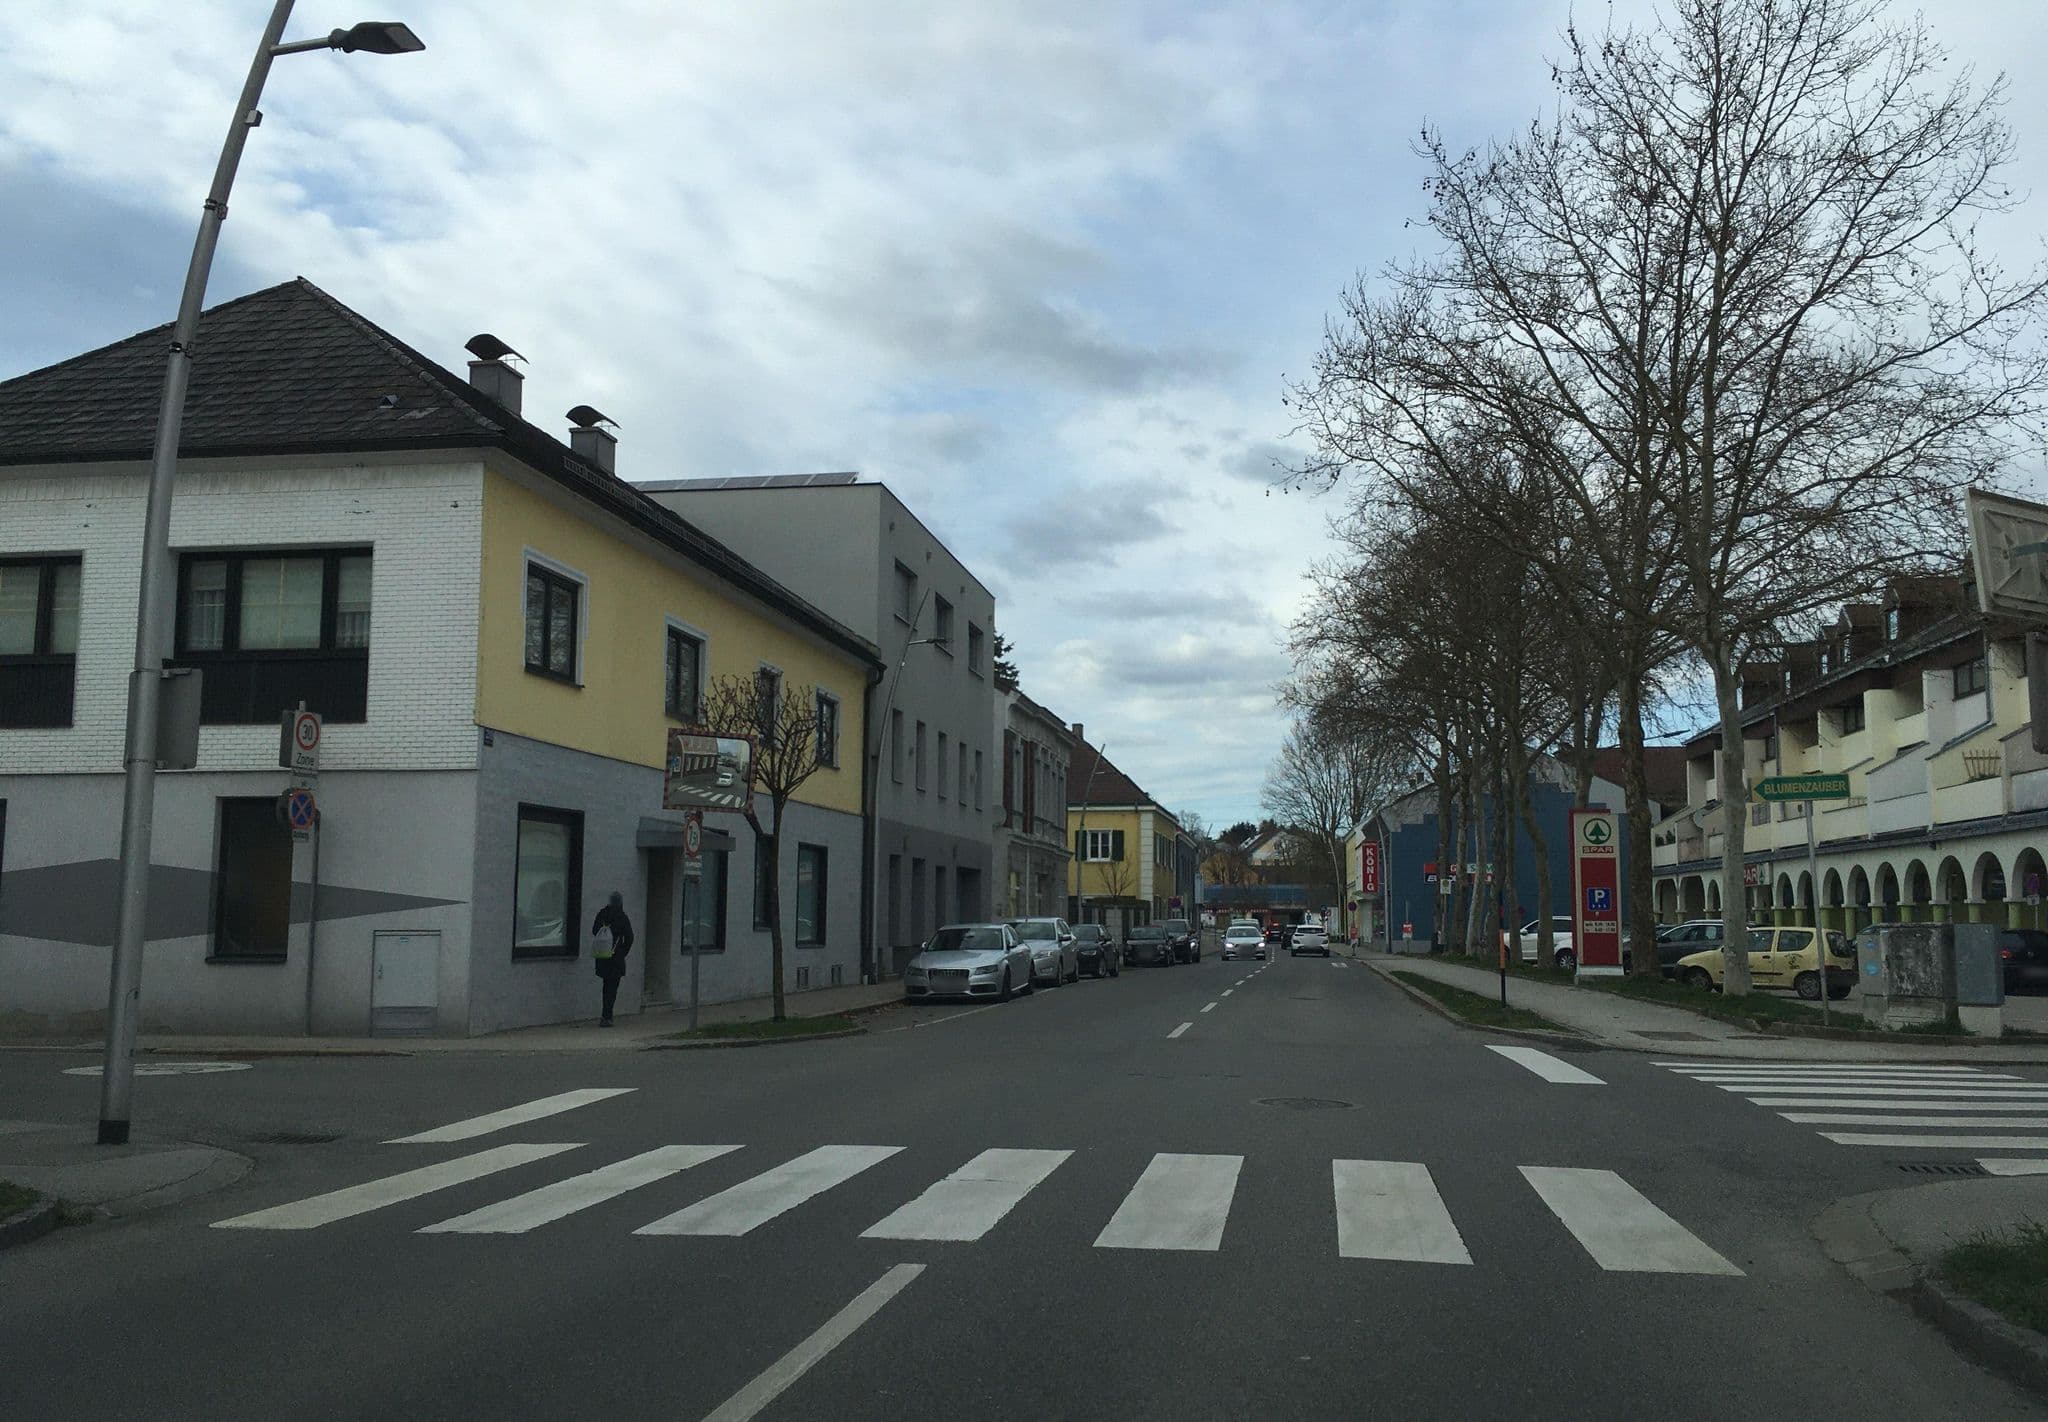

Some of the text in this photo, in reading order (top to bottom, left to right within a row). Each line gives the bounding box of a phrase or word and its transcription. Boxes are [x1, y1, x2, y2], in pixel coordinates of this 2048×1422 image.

[303, 724, 313, 741] 30
[296, 753, 315, 767] Zone
[1764, 781, 1847, 794] BLUMENZAUBER
[1594, 889, 1606, 903] P
